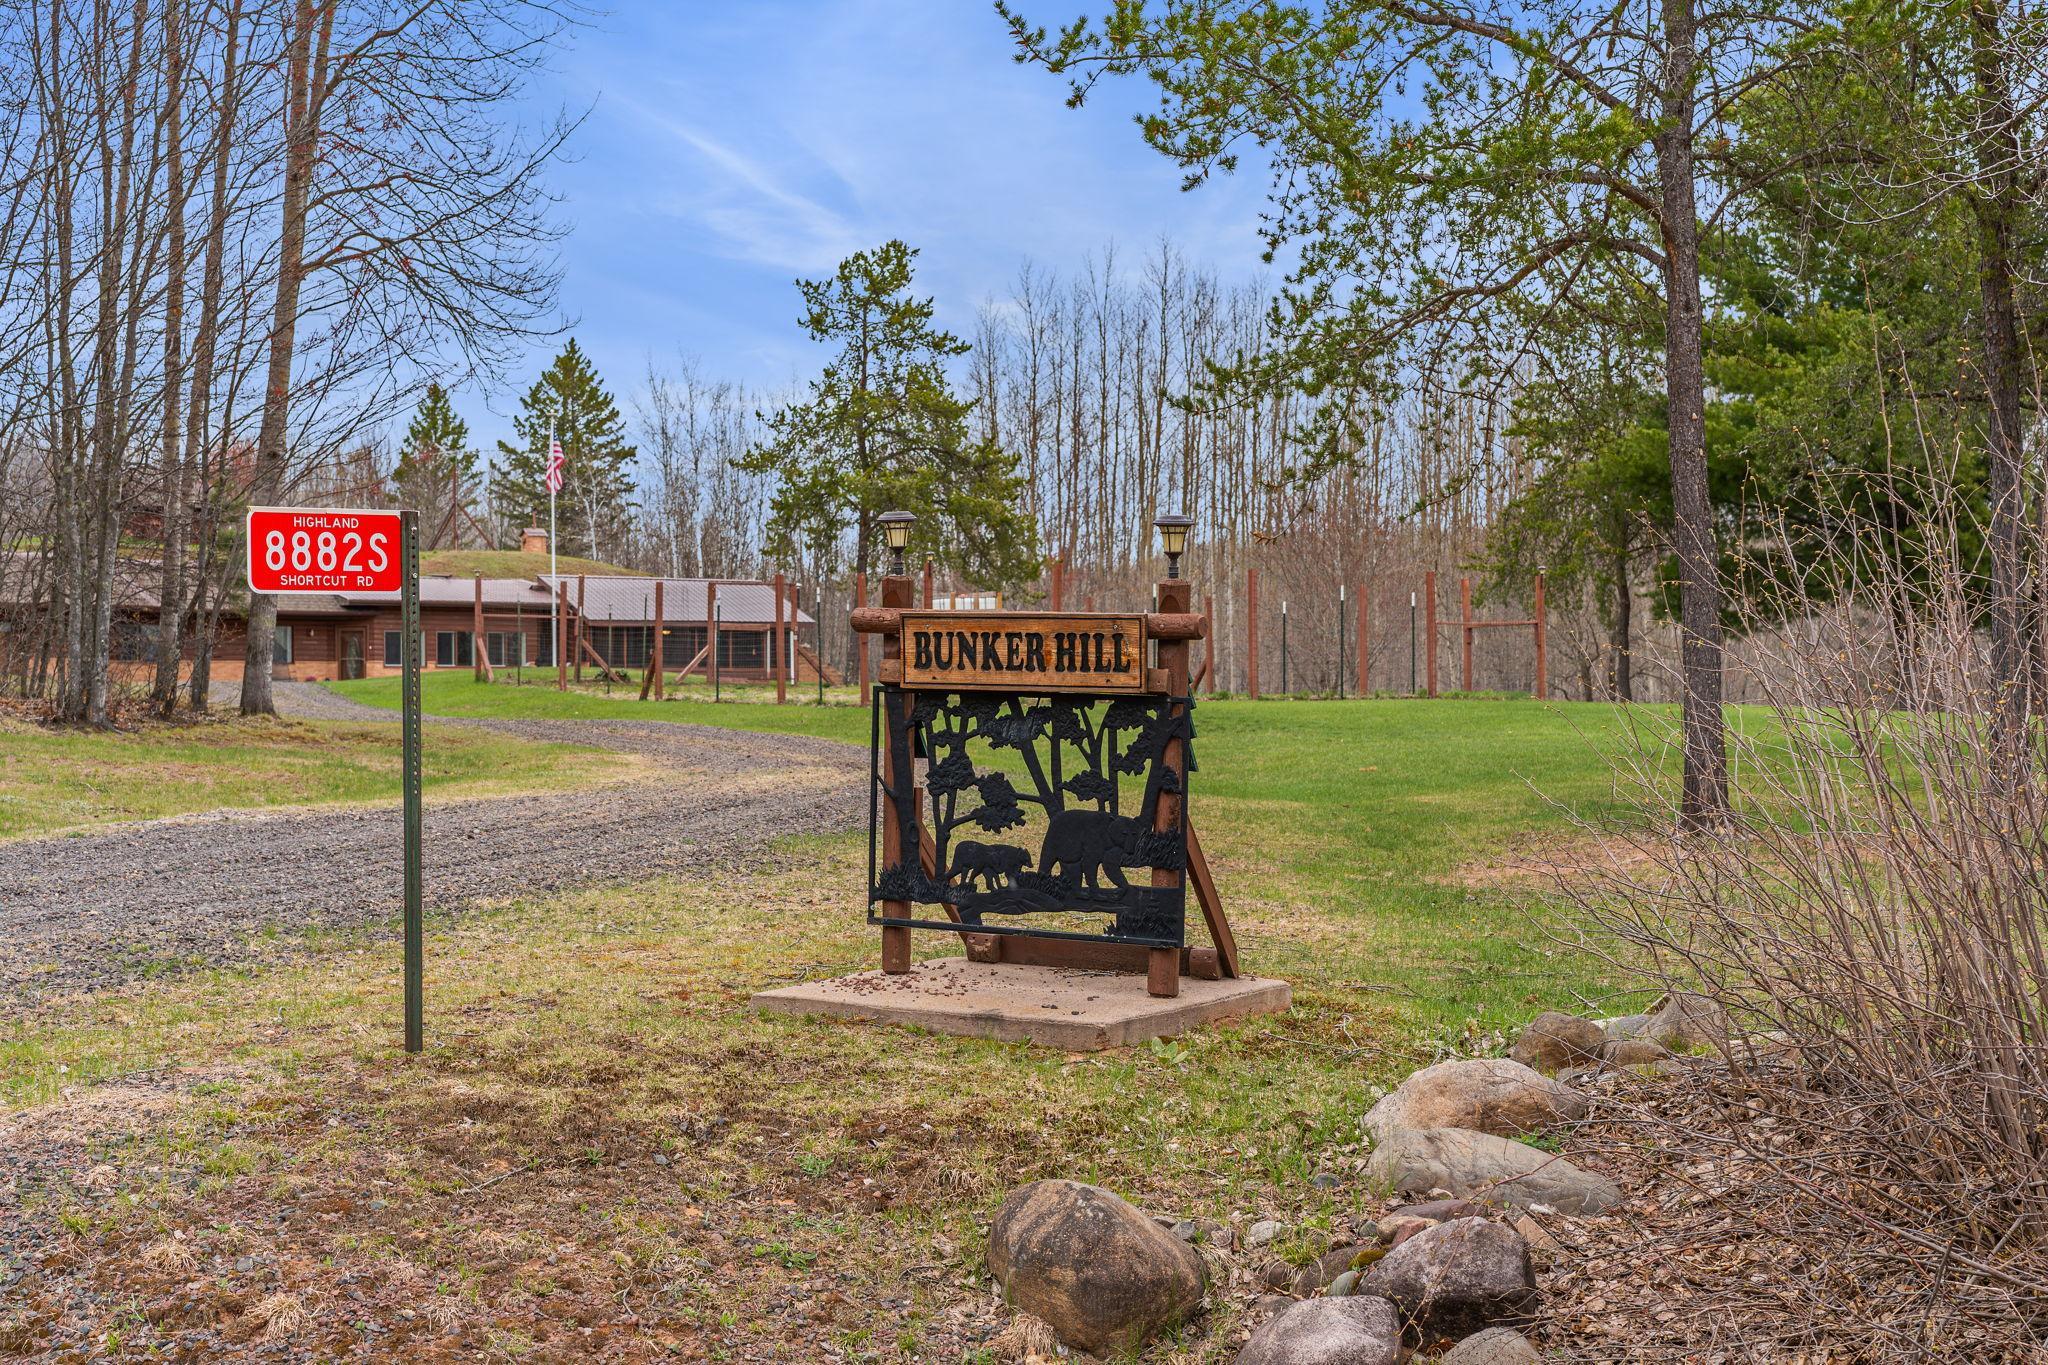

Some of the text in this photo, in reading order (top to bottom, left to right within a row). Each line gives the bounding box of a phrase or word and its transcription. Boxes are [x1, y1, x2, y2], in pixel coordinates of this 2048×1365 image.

[293, 516, 359, 529] HIGHLAND
[265, 530, 388, 573] 8882S
[280, 574, 374, 587] SHORTCUT RD
[913, 630, 1131, 673] BUNKER HILL
